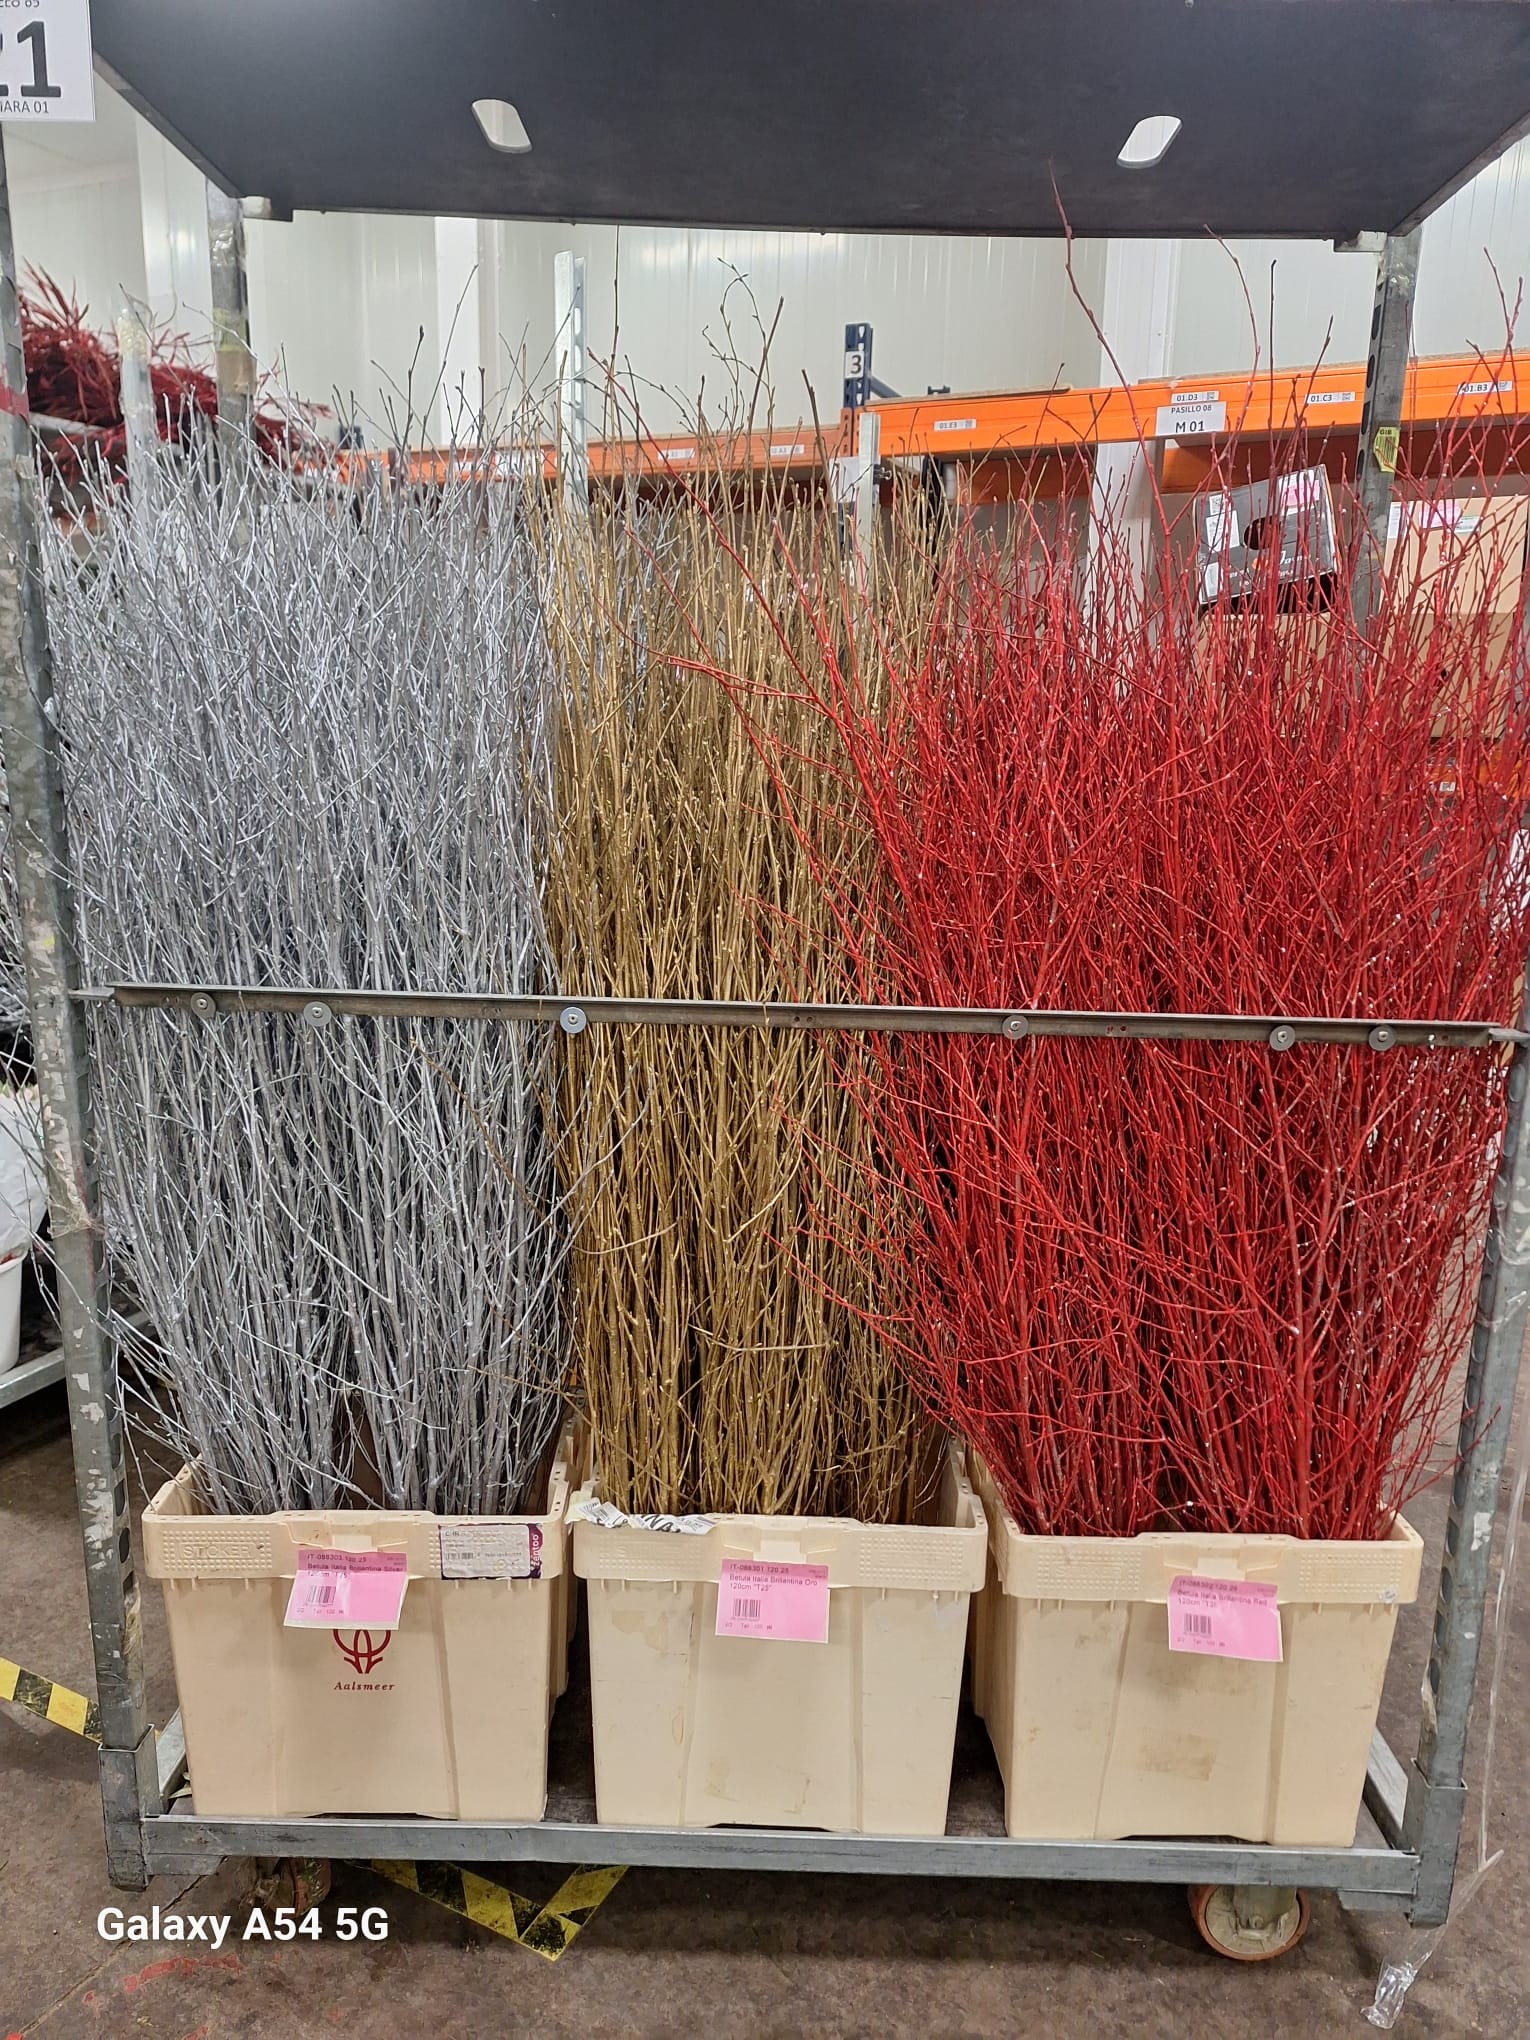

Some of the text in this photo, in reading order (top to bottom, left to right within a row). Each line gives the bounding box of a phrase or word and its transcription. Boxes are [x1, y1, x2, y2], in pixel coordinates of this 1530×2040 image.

[0, 20, 61, 98] 1
[0, 100, 49, 114] ARA 01
[850, 354, 862, 375] 3
[1176, 393, 1198, 402] 01.D3
[1310, 394, 1333, 402] 01.C3
[1171, 405, 1202, 414] PASILLO
[1175, 420, 1205, 433] M 01
[333, 1681, 396, 1691] Aalsmeer
